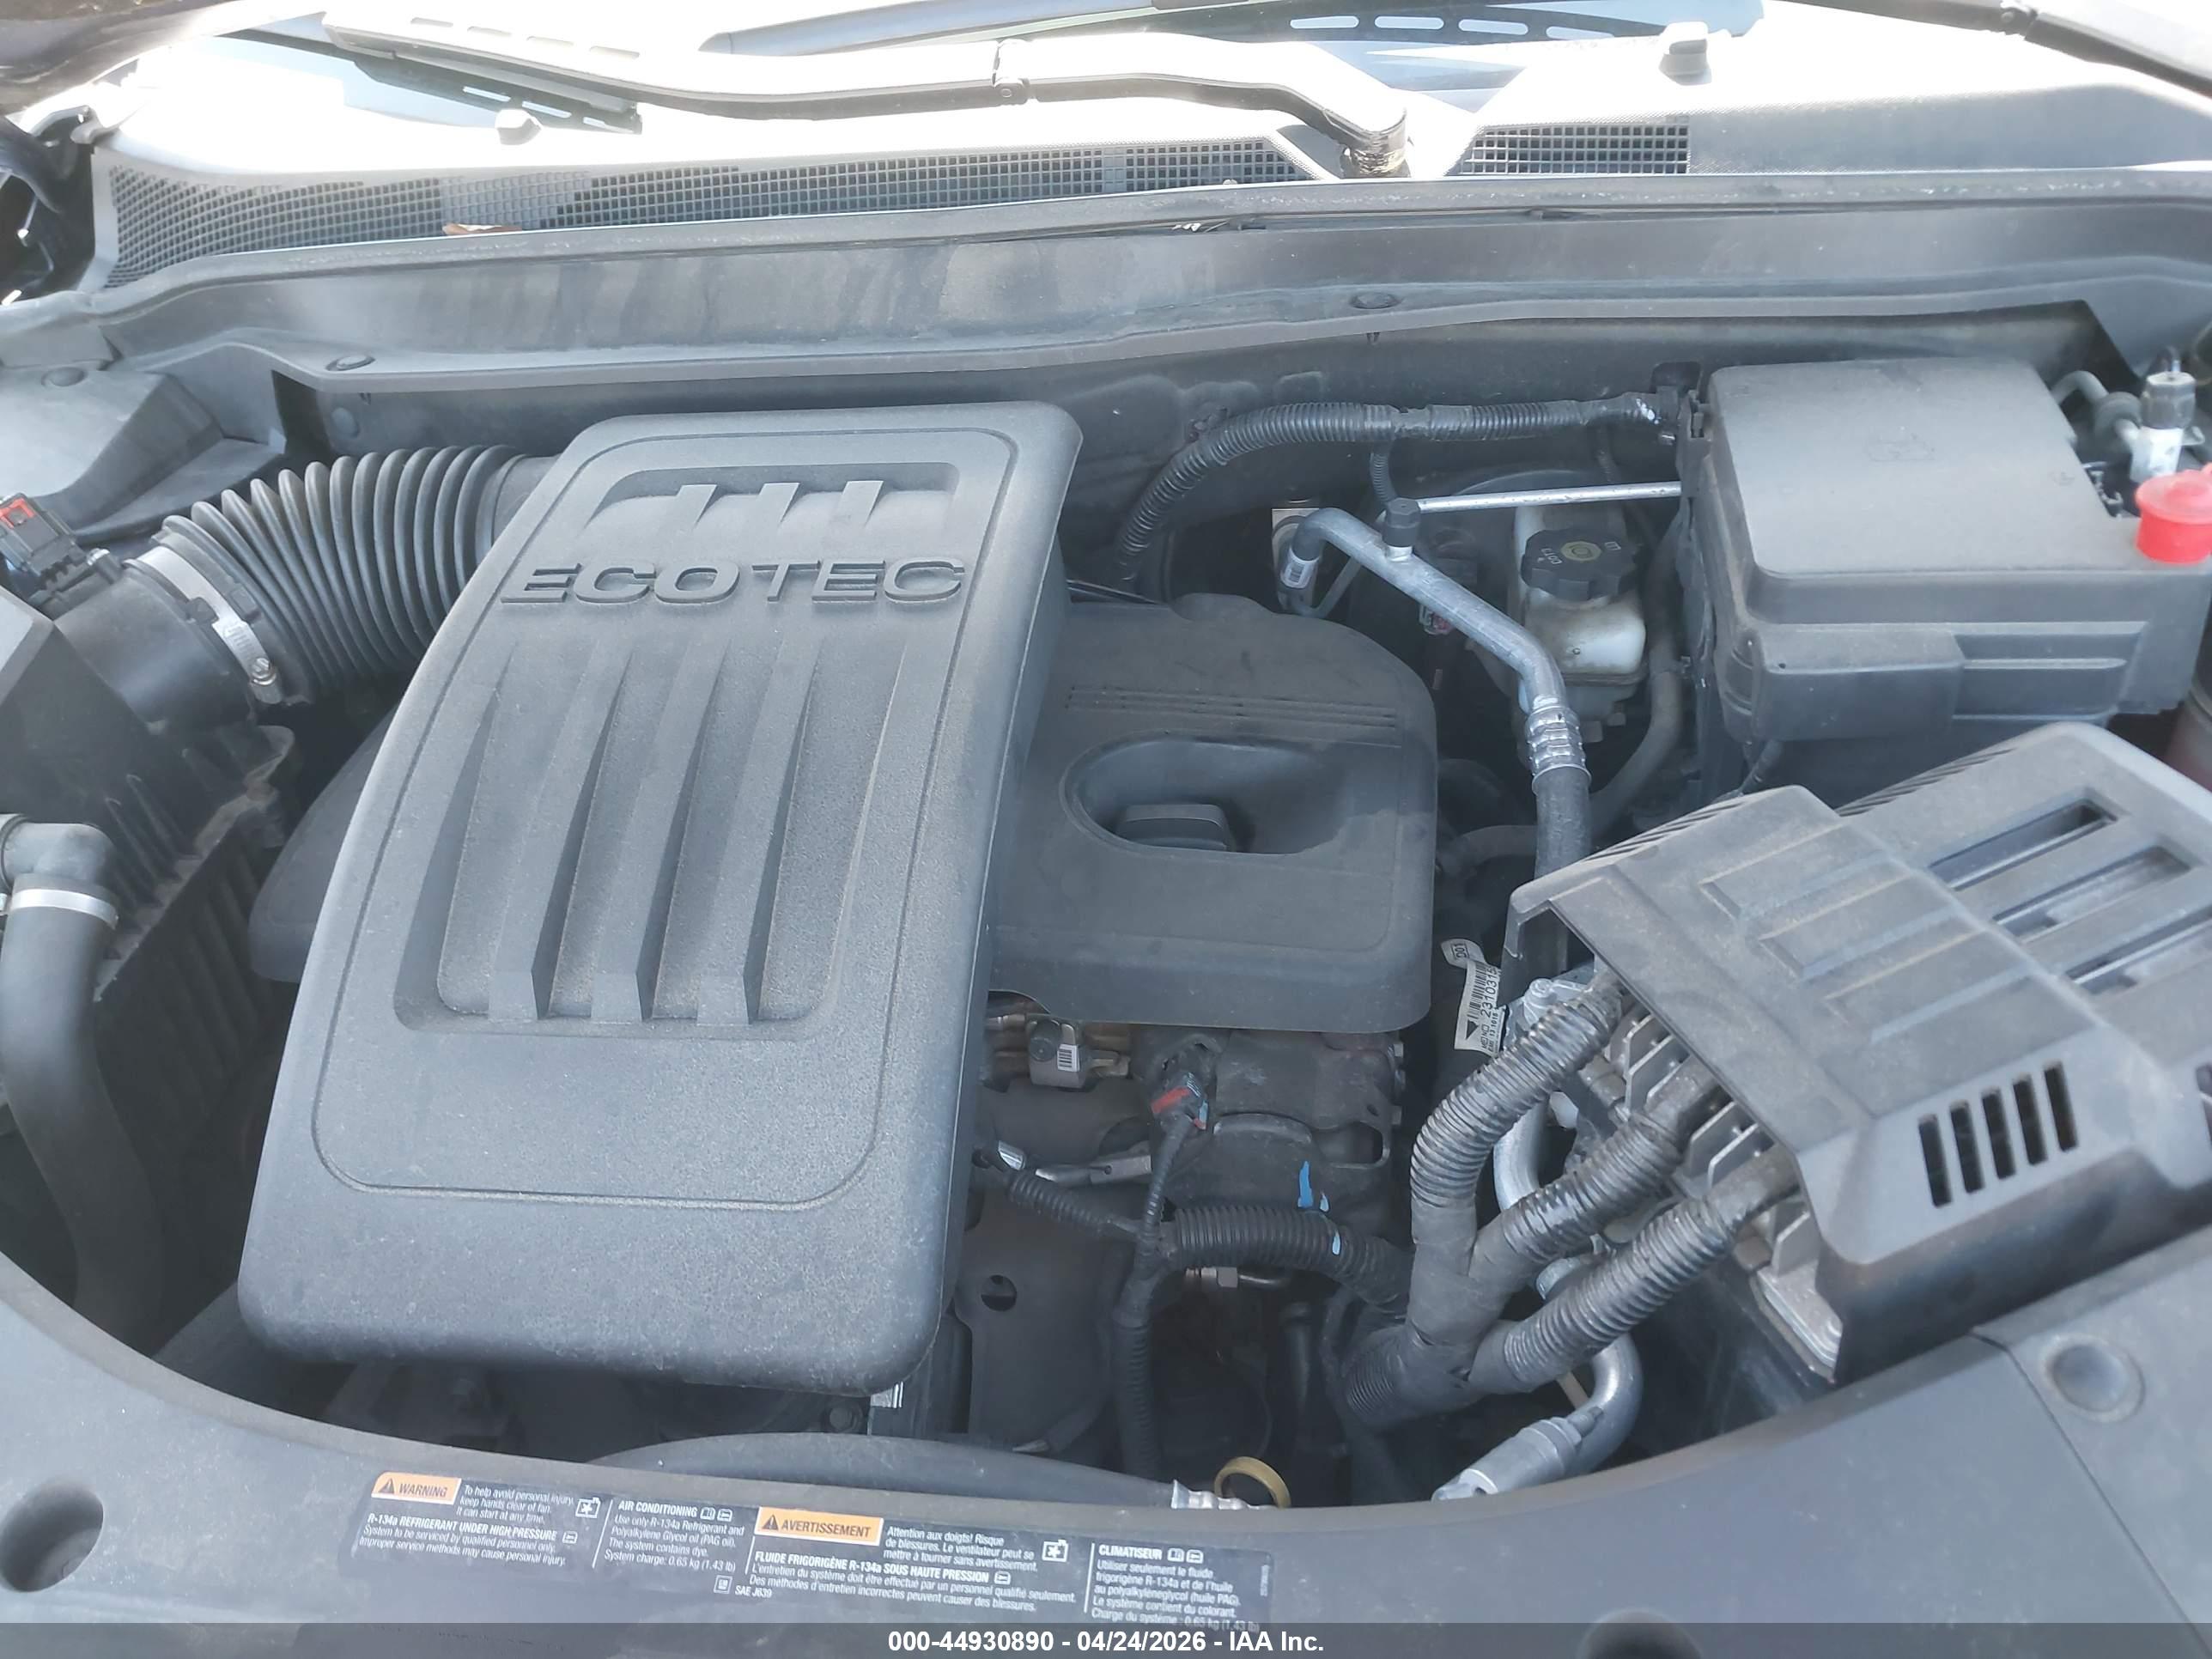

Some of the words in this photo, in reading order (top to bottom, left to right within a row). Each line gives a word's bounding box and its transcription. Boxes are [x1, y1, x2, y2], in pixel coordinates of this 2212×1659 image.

[501, 560, 965, 604] ECOTEC
[398, 1483, 448, 1498] WARNING
[465, 1485, 473, 1495] To
[475, 1486, 491, 1498] help
[493, 1488, 515, 1499] avoid
[515, 1491, 550, 1503] personal
[460, 1495, 479, 1508] keep
[481, 1498, 505, 1509] hands
[507, 1501, 526, 1510] clear
[527, 1503, 536, 1511] of
[618, 1500, 634, 1512] AIR
[635, 1502, 697, 1518] CONDITIONING
[368, 1512, 398, 1526] R-134a
[399, 1516, 459, 1531] REFRIGERANT
[459, 1522, 489, 1534] UNDER
[489, 1524, 511, 1537] HIGH
[512, 1527, 557, 1541] PRESSURE
[464, 1509, 477, 1517] can
[480, 1509, 498, 1519] start
[499, 1510, 508, 1520] at
[509, 1512, 524, 1522] any
[614, 1514, 629, 1524] Use
[632, 1516, 647, 1527] only
[650, 1516, 680, 1529] R-134a
[682, 1520, 727, 1534] Refrigerant
[728, 1525, 744, 1536] and
[364, 1524, 392, 1537] System
[394, 1528, 403, 1537] to
[404, 1529, 414, 1539] be
[416, 1531, 449, 1543] serviced
[450, 1534, 460, 1545] by
[462, 1534, 496, 1547] qualified
[496, 1538, 537, 1551] personnel
[611, 1525, 660, 1540] Polyalkylene
[662, 1529, 687, 1543] Glycol
[689, 1533, 699, 1543] oil
[781, 1519, 872, 1538] AVERTISSEMENT
[887, 1526, 925, 1539] Attention
[927, 1531, 943, 1540] aux
[944, 1531, 973, 1545] doigts!
[975, 1533, 1005, 1547] Risque
[359, 1536, 394, 1549] Improper
[396, 1540, 424, 1552] service
[426, 1542, 461, 1555] methods
[462, 1547, 479, 1559] may
[481, 1549, 505, 1560] cause
[506, 1552, 542, 1563] personal
[609, 1536, 623, 1547] The
[624, 1540, 653, 1551] system
[656, 1543, 690, 1555] contains
[691, 1547, 708, 1558] dye.
[885, 1537, 897, 1547] de
[898, 1538, 940, 1552] blessures.
[943, 1542, 953, 1553] Le
[956, 1543, 1000, 1557] ventilateur
[1002, 1548, 1022, 1559] peut
[1024, 1551, 1035, 1560] se
[1098, 1544, 1163, 1560] CLIMATISEUR
[605, 1548, 635, 1562] System
[636, 1553, 667, 1565] charge:
[668, 1556, 688, 1566] 0.65
[689, 1559, 700, 1570] kg
[701, 1559, 723, 1571] (1.43
[725, 1561, 736, 1572] lb)
[755, 1551, 787, 1564] FLUIDE
[787, 1553, 848, 1570] FRIGORIGÈNE
[848, 1559, 882, 1574] R-134a
[883, 1563, 908, 1576] SOUS
[910, 1565, 941, 1578] HAUTE
[942, 1568, 989, 1583] PRESSION
[883, 1549, 912, 1561] mettre
[921, 1552, 952, 1564] tourner
[953, 1556, 974, 1566] sans
[975, 1557, 1037, 1572] avertissement.
[752, 1563, 795, 1577] L'entretien
[798, 1566, 808, 1578] du
[847, 1571, 864, 1583] doit
[921, 1580, 936, 1591] par
[938, 1582, 949, 1591] un
[950, 1583, 994, 1595] personnel
[735, 1585, 751, 1596] SAE
[750, 1574, 766, 1586] Des
[811, 1580, 856, 1595] d'entretien
[858, 1586, 905, 1600] incorrectes
[907, 1591, 942, 1603] peuvent
[943, 1595, 973, 1606] causer
[974, 1596, 990, 1608] des
